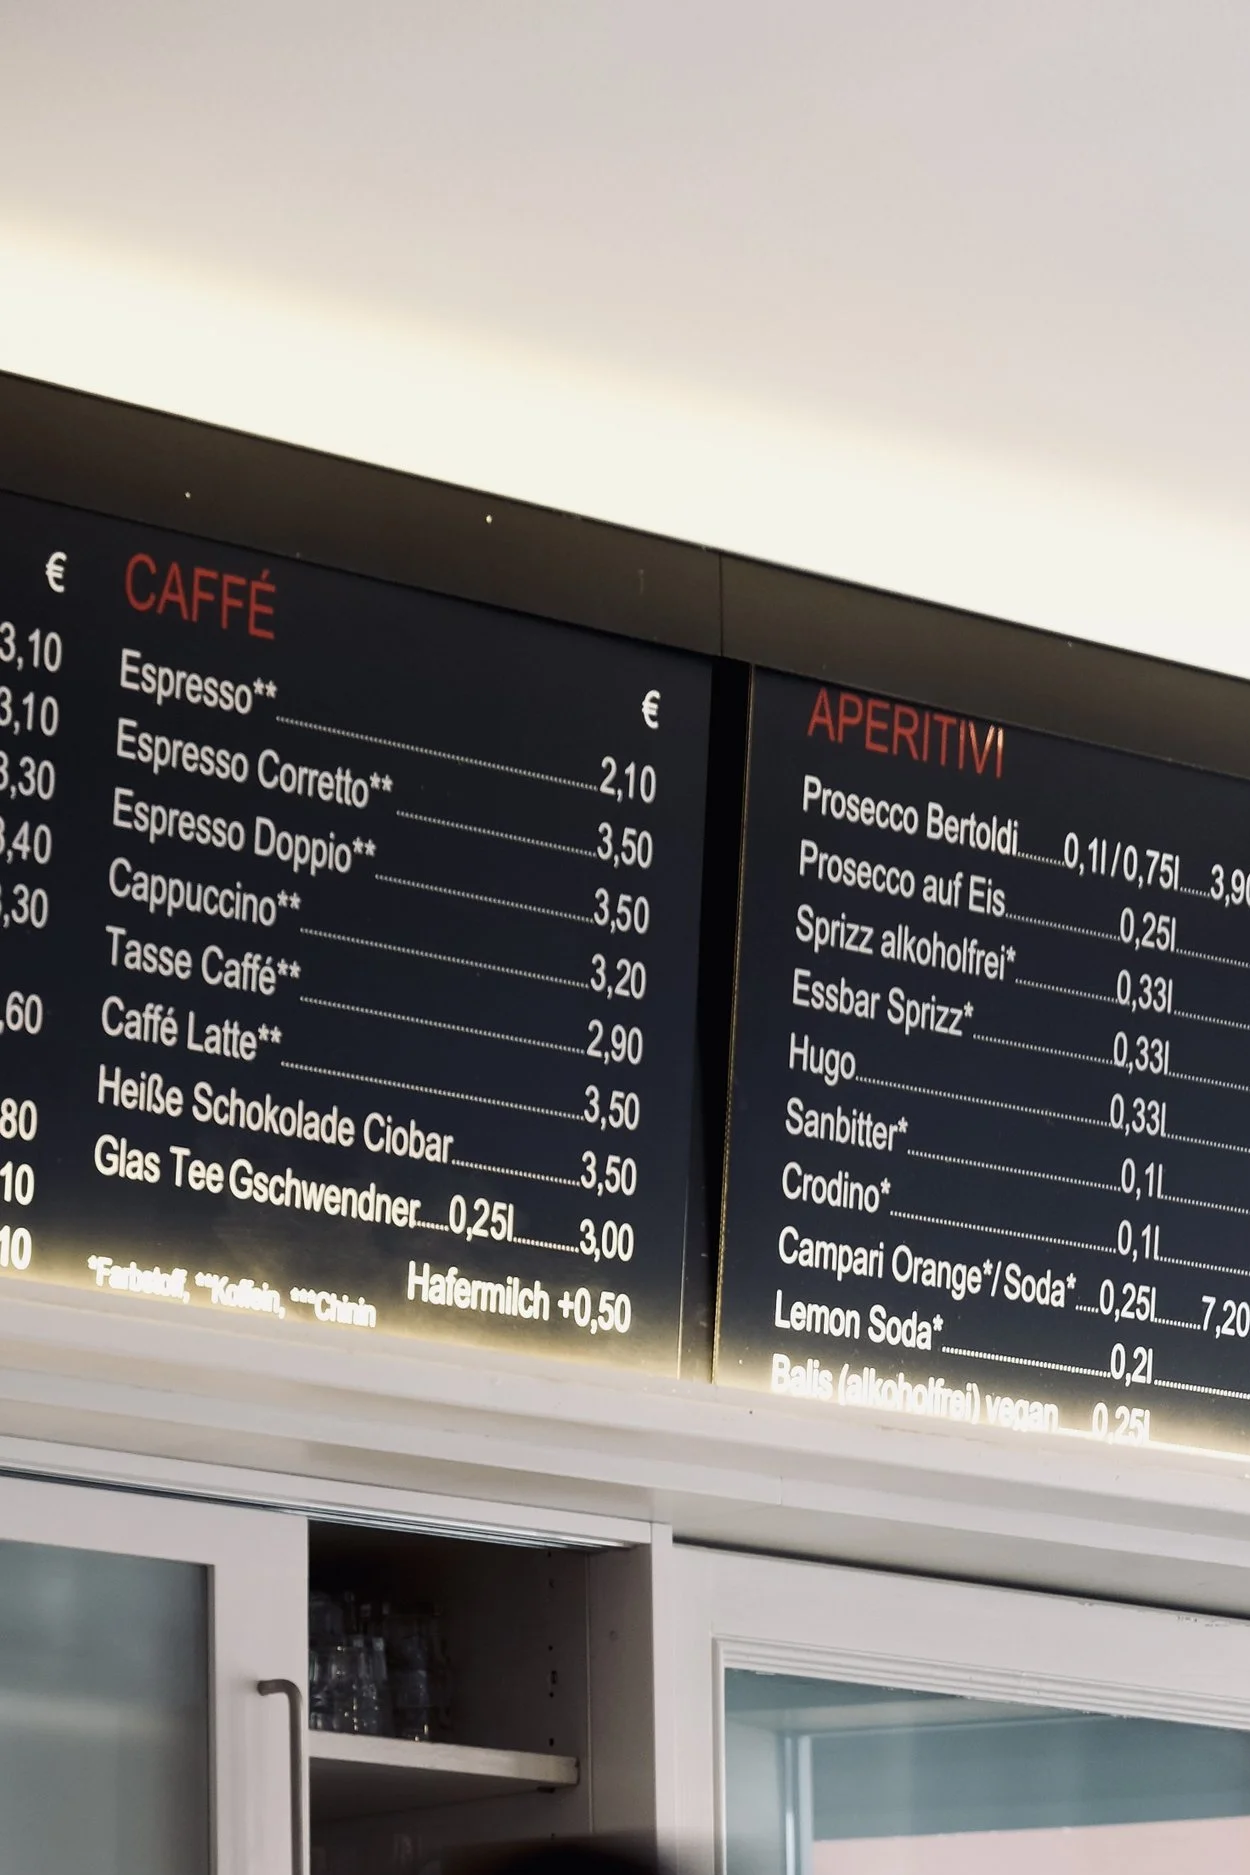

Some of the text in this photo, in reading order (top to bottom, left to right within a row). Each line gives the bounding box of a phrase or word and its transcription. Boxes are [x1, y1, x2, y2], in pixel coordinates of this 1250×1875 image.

[46, 552, 66, 592] €
[126, 554, 275, 639] CAFFÉ
[0, 622, 61, 671] 3,10
[0, 686, 58, 735] 3,10
[642, 690, 660, 728] €
[808, 690, 1003, 777] APERITIVI
[117, 718, 248, 782] Espresso
[598, 823, 652, 868] 3,50
[600, 757, 656, 802] 2,10
[803, 775, 1017, 855] Prosecco Bertoldi
[114, 788, 244, 850] Espresso
[594, 888, 649, 933] 3,50
[800, 840, 915, 897] Prosecco
[923, 872, 963, 907] auf
[969, 875, 1005, 916] Eis
[1121, 908, 1176, 951] 0,25l
[106, 926, 191, 979] Tasse
[587, 1020, 642, 1064] 2,90
[591, 954, 645, 999] 3,20
[796, 905, 873, 954] Sprizz
[1117, 970, 1172, 1013] 0,33l
[102, 996, 177, 1046] Caffé
[584, 1085, 639, 1130] 3,50
[793, 968, 880, 1019] Essbar
[1114, 1032, 1169, 1075] 0,33l
[98, 1064, 636, 1196] Heiße Schokolade Ciobar 3,50
[790, 1033, 855, 1085] Hugo
[1109, 1094, 1166, 1137] 0,33l
[95, 1135, 633, 1262] Glas Tee Gschwendner 0,25l 3,00
[1122, 1159, 1163, 1200] 0,1l
[779, 1226, 884, 1281] Campari
[1100, 1279, 1157, 1322] 0,25l
[1118, 1220, 1159, 1262] 0,1l
[407, 1261, 631, 1334] Hafermilch +0,50
[775, 1290, 860, 1339] Lemon
[1108, 1343, 1152, 1387] 0,2l
